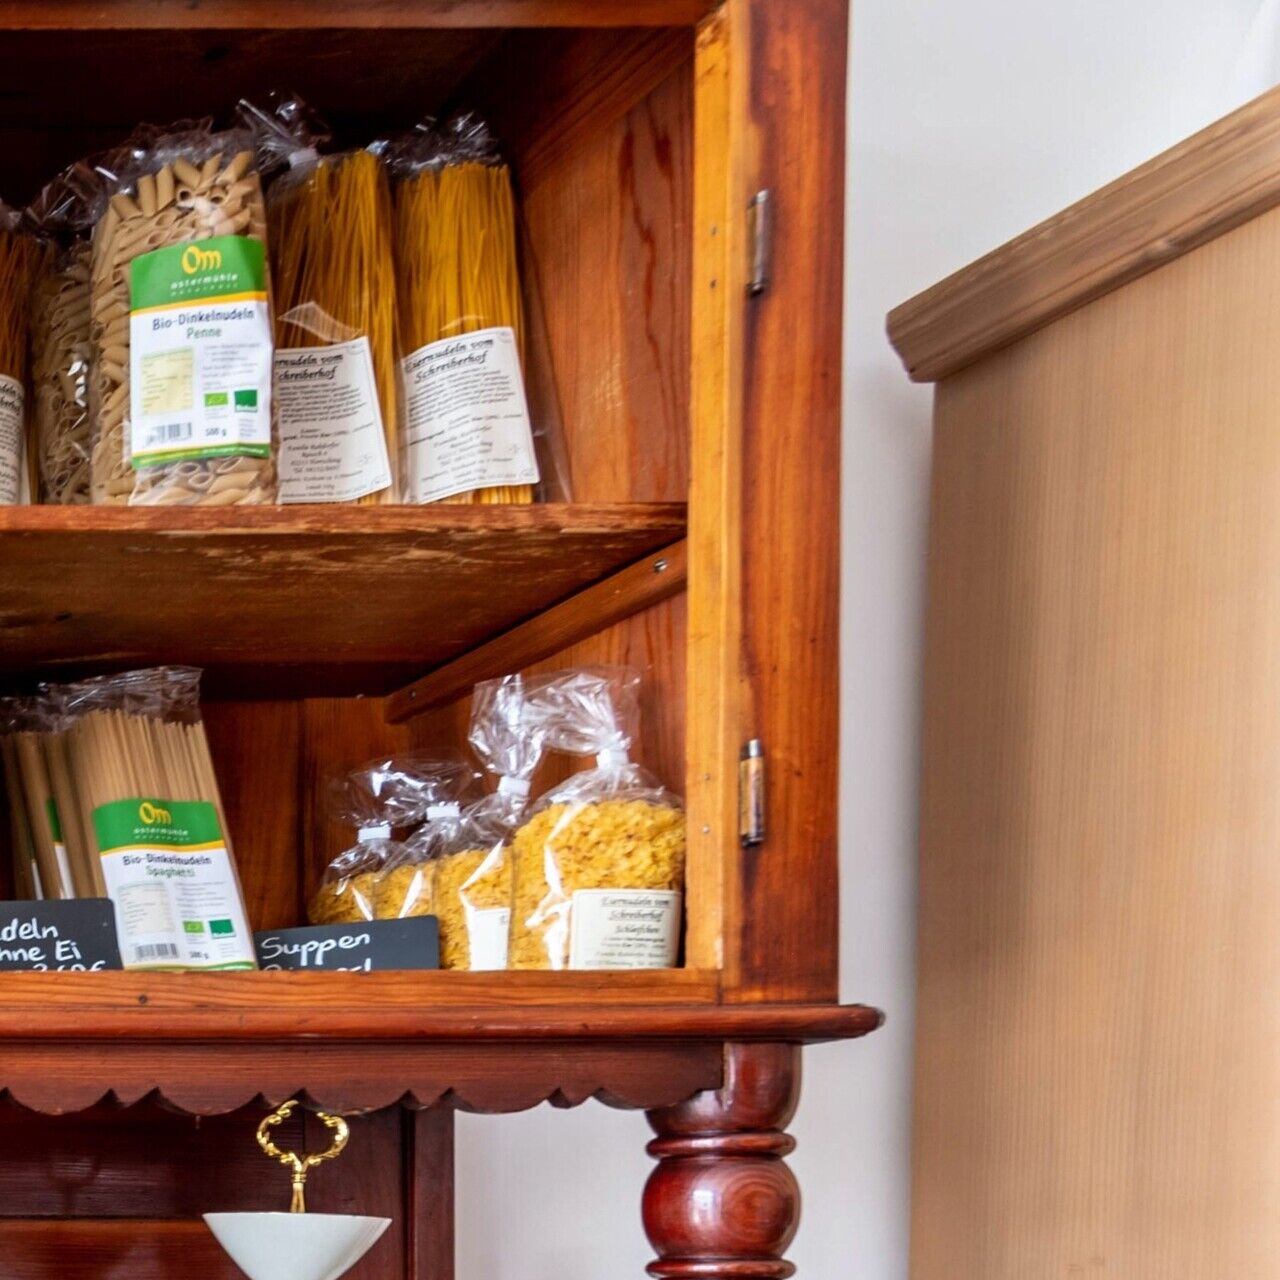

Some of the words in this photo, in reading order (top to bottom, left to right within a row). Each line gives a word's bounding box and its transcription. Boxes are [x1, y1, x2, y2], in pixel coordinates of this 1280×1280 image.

[181, 246, 221, 274] Om
[152, 307, 254, 331] Bio-Dinkelnudeln
[187, 327, 221, 339] Penne
[278, 366, 338, 382] chreiberhof
[139, 802, 171, 824] Om
[55, 940, 82, 961] Ei
[261, 933, 370, 966] Suppen
